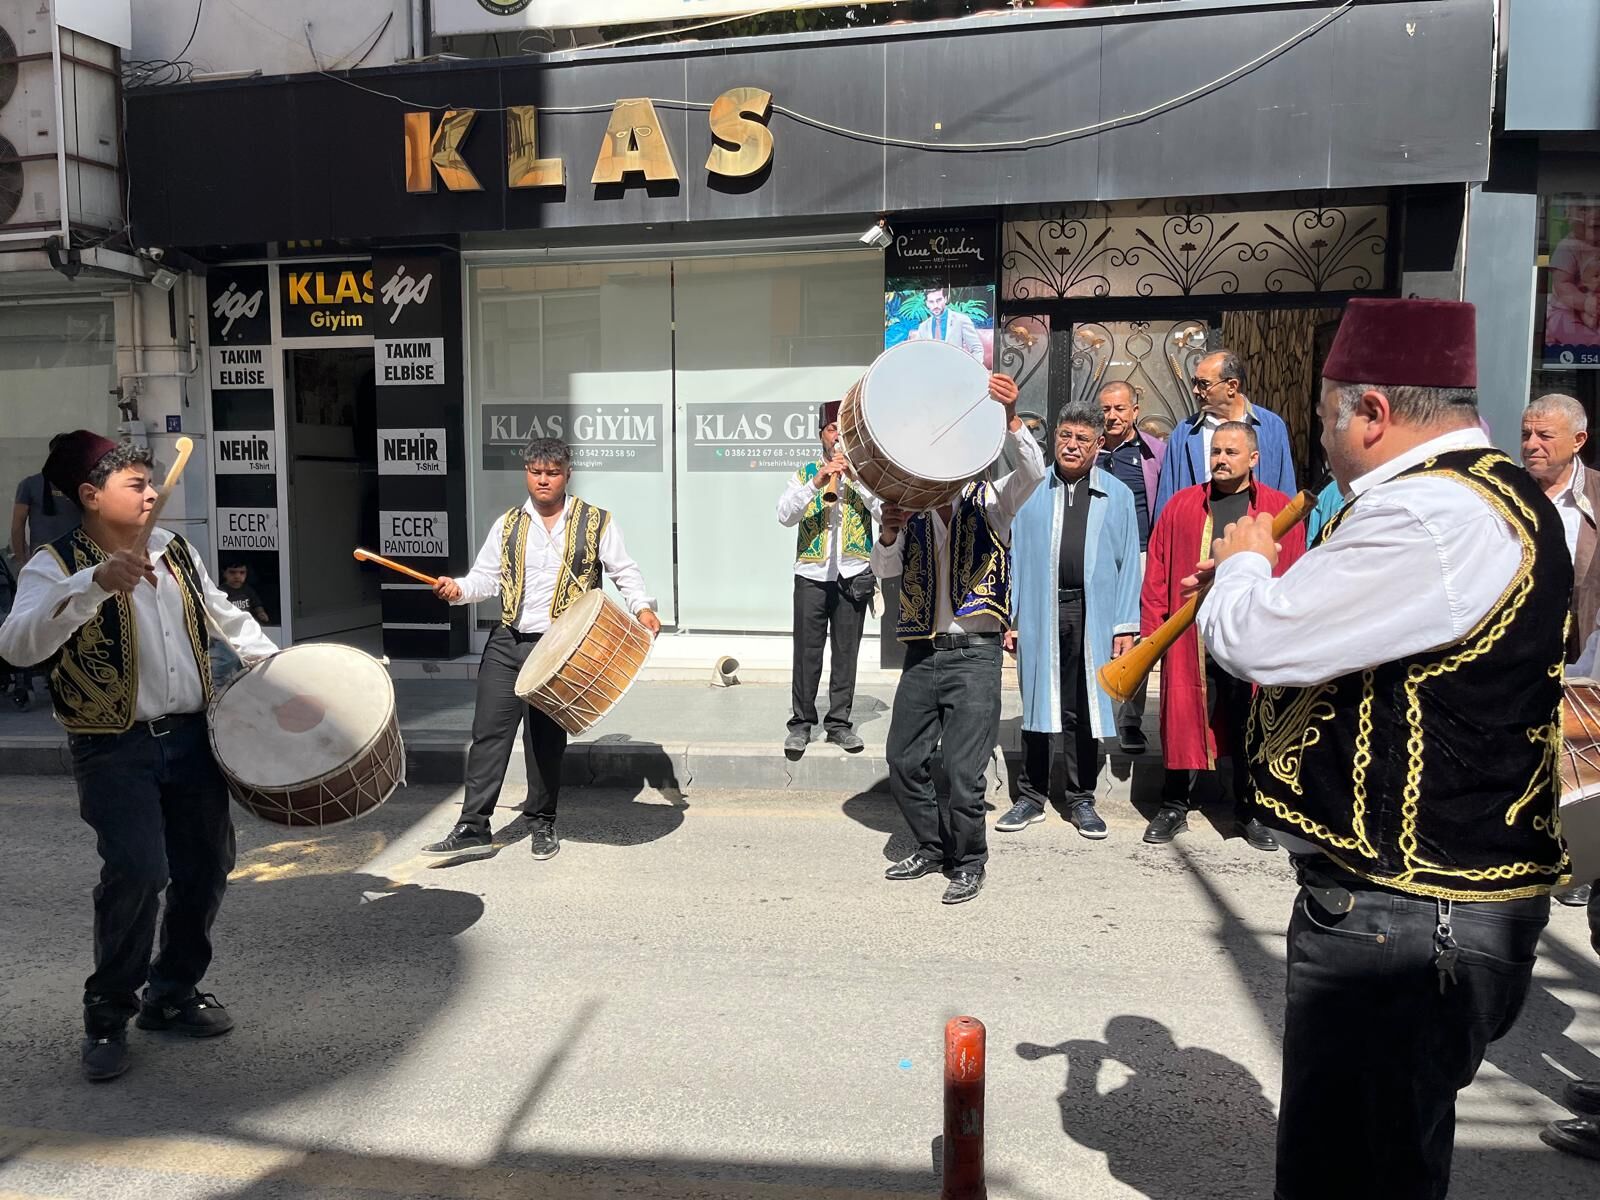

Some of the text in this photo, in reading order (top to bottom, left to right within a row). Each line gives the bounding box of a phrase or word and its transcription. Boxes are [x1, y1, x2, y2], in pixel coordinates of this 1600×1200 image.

[404, 87, 774, 193] KLAS
[896, 235, 985, 261] Pierre Cardin
[310, 310, 363, 331] Giyim
[220, 350, 262, 364] TAKIM
[385, 342, 432, 358] TAKIM
[1581, 354, 1599, 363] 554
[220, 367, 265, 385] ELBİSE
[384, 362, 434, 381] ELBİSE
[490, 407, 657, 441] KLAS GİYİM
[695, 405, 819, 440] KLAS Gİ
[220, 434, 269, 461] NEHİR
[383, 432, 438, 461] NEHİR
[725, 449, 730, 457] 0
[732, 449, 745, 457] 386
[747, 449, 760, 457] 212
[763, 449, 772, 457] 67
[773, 449, 783, 457] 68
[789, 449, 795, 457] 0
[796, 449, 810, 457] 542
[250, 462, 270, 470] T-Shirt
[416, 462, 439, 471] T-Shirt
[222, 535, 275, 548] PANTOLON
[384, 541, 443, 554] PANTOLON
